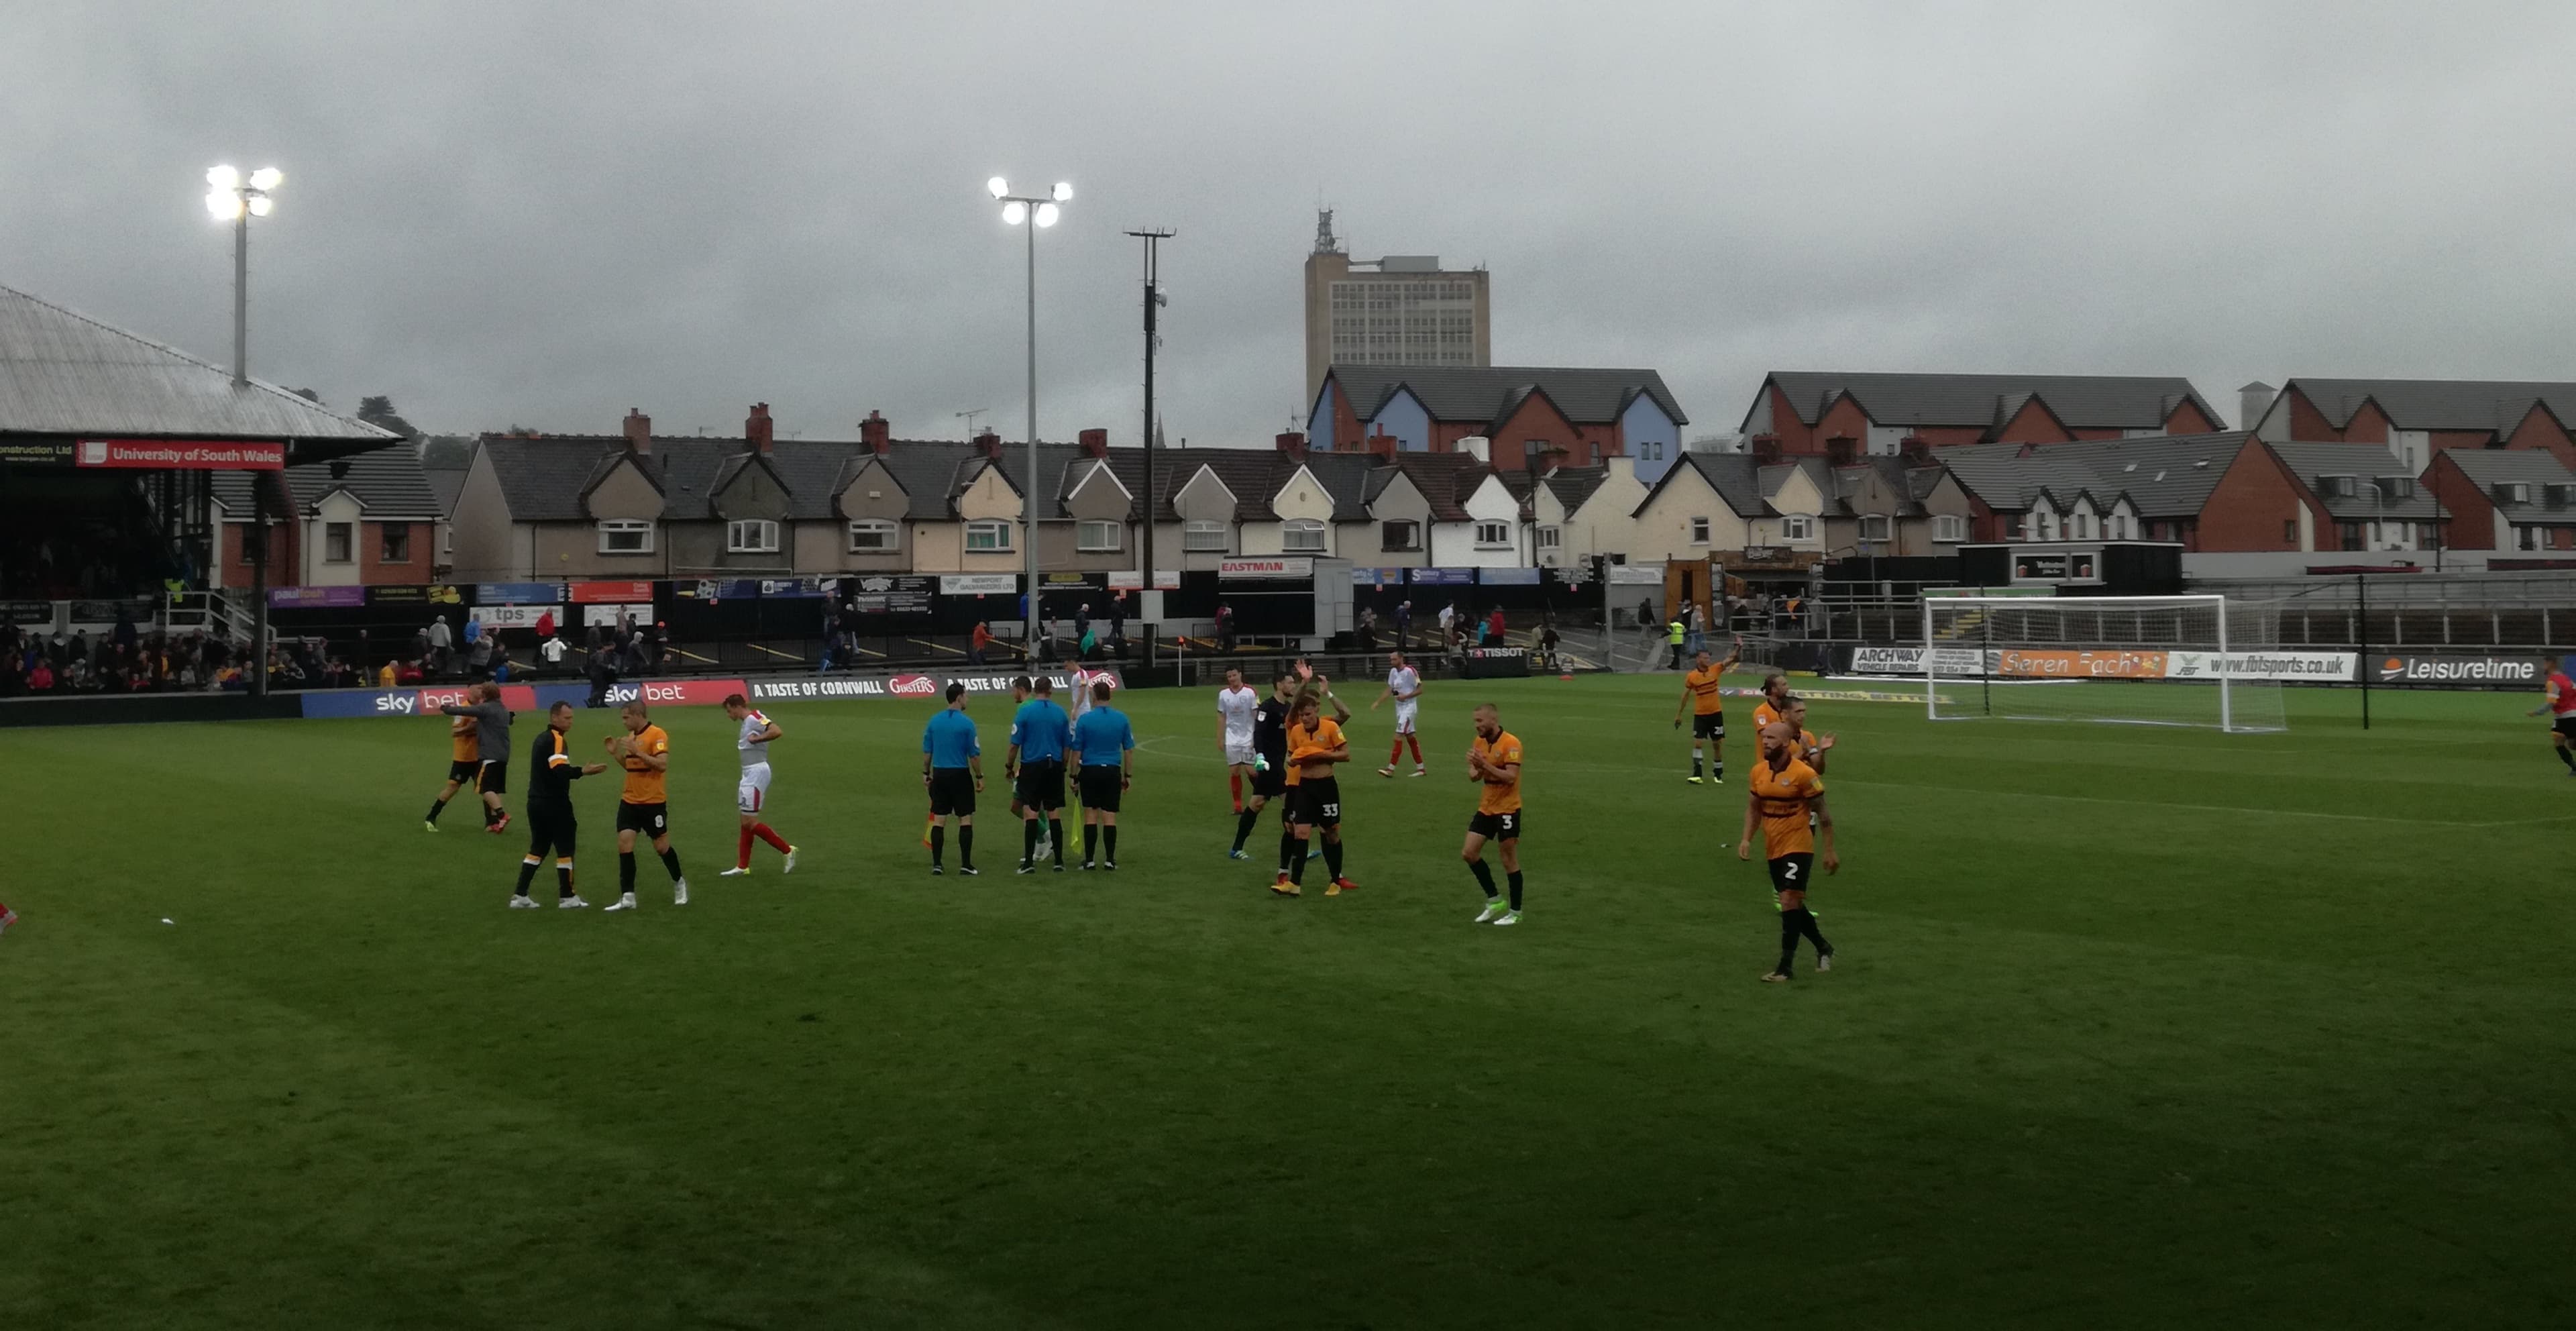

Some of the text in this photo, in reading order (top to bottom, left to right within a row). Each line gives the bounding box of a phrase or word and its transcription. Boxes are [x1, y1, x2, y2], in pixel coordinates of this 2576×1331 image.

[56, 445, 72, 454] Ltd
[113, 447, 282, 463] University of South Wales
[1222, 562, 1283, 571] EASTMAN
[495, 607, 525, 621] tps
[1483, 647, 1525, 657] TISSOT
[1858, 649, 1925, 662] ARCHWAY
[1858, 663, 1919, 672] VEHICLE REPAIRS
[2003, 651, 2131, 675] Seren Fach
[2407, 658, 2534, 679] Leisuretime
[754, 681, 884, 698] A TASTE OF CORNWALL
[994, 677, 1006, 690] OF
[604, 684, 686, 702] sky bet
[376, 692, 464, 714] sky bet
[1322, 803, 1339, 817] 33
[655, 814, 664, 829] 8
[1502, 814, 1513, 830] 3
[1784, 861, 1799, 880] 2
